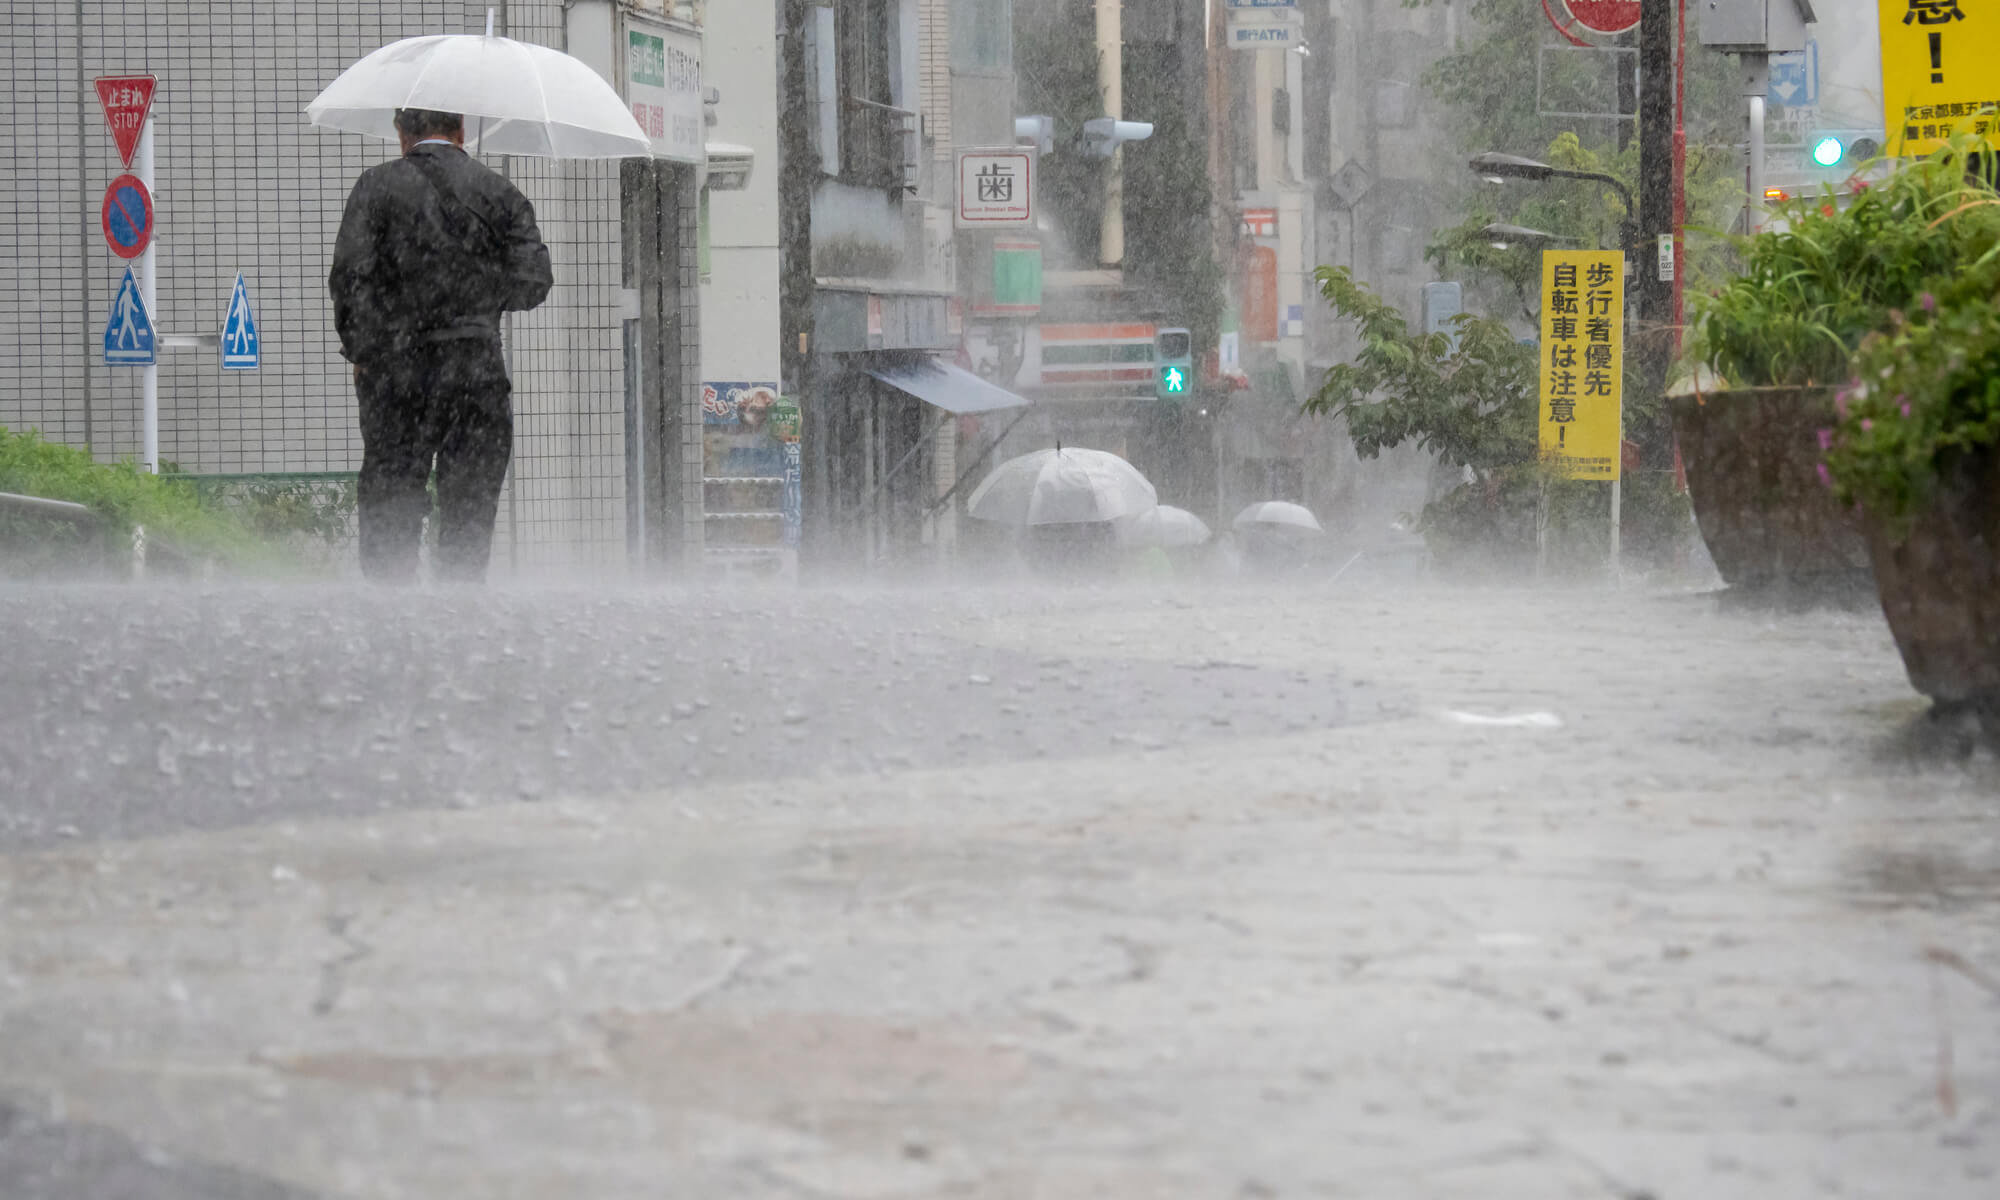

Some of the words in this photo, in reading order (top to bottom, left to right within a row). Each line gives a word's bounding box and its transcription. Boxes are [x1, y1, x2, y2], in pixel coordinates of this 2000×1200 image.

[107, 86, 145, 107] 止まれ
[113, 111, 139, 129] STOP
[974, 163, 1016, 202] 歯
[1584, 262, 1614, 396] 歩行者優先
[1548, 262, 1579, 449] 自転車は注意!
